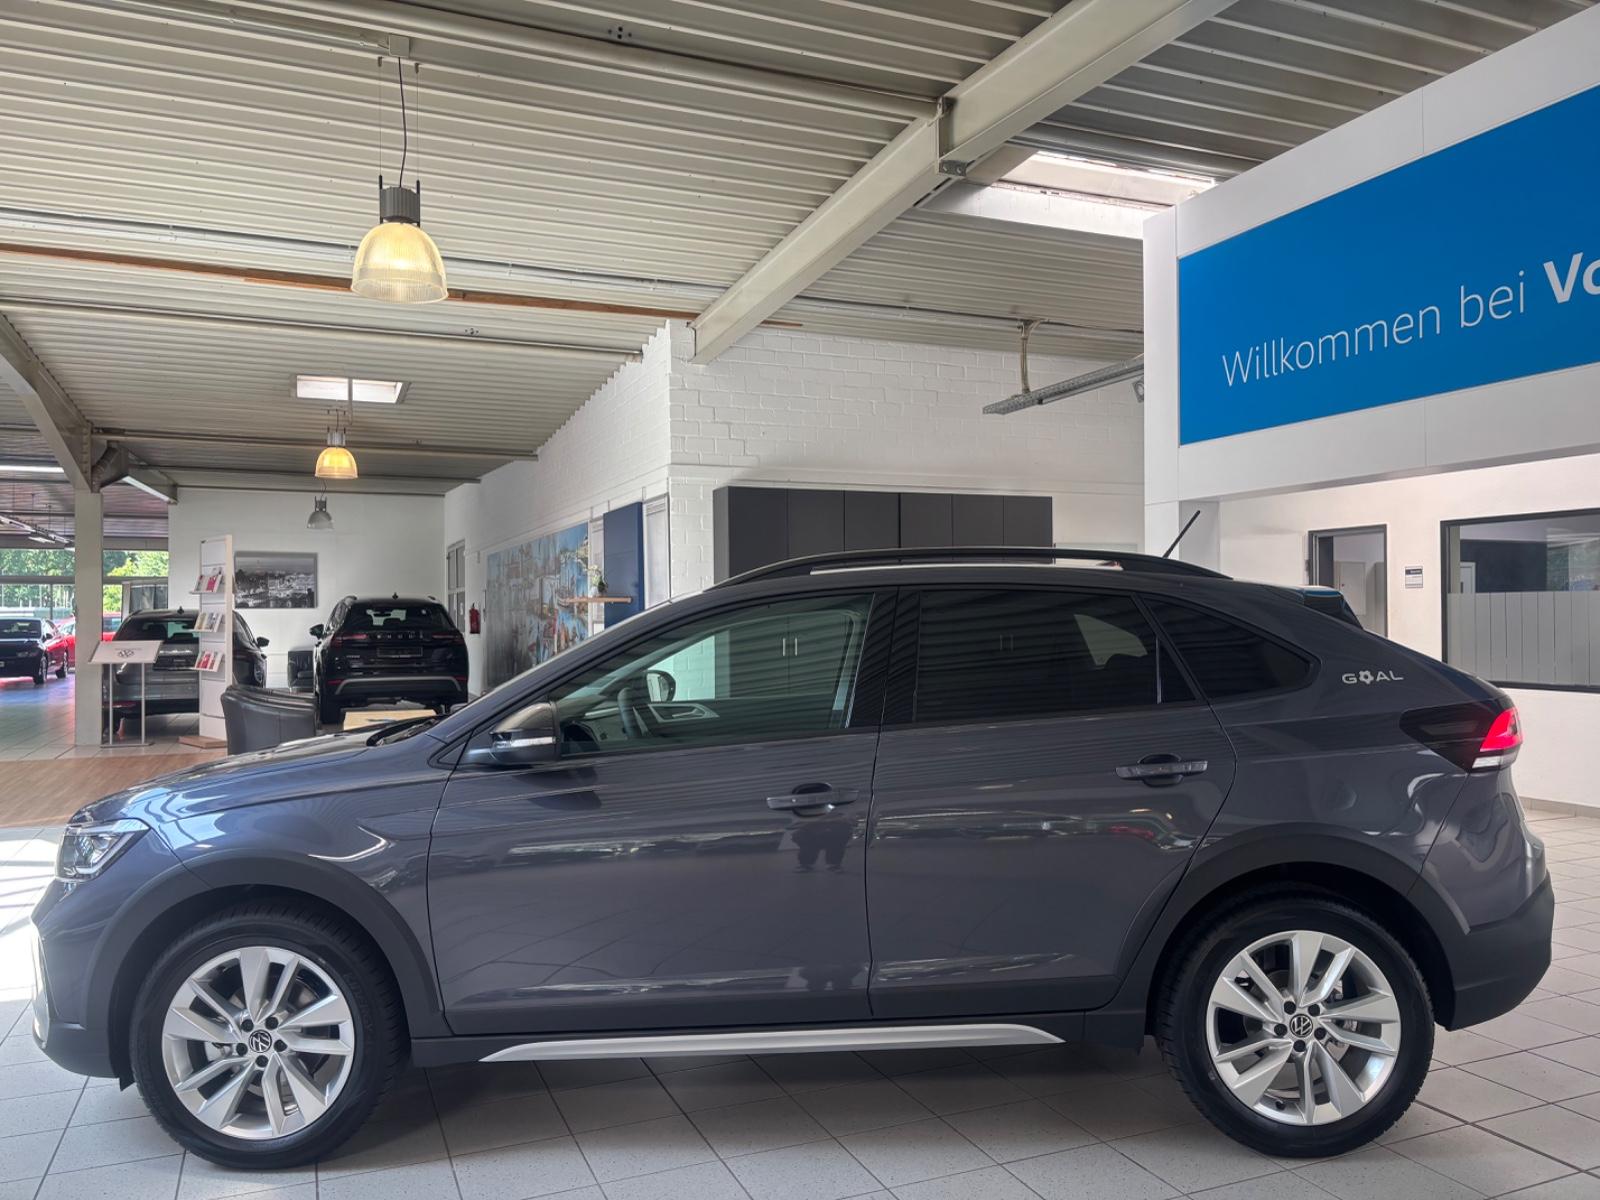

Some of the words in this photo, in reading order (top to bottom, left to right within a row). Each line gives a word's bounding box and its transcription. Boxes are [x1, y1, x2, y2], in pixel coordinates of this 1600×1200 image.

[1222, 305, 1441, 387] Willkommen
[1459, 270, 1525, 328] bei
[1341, 670, 1404, 684] GOAL
